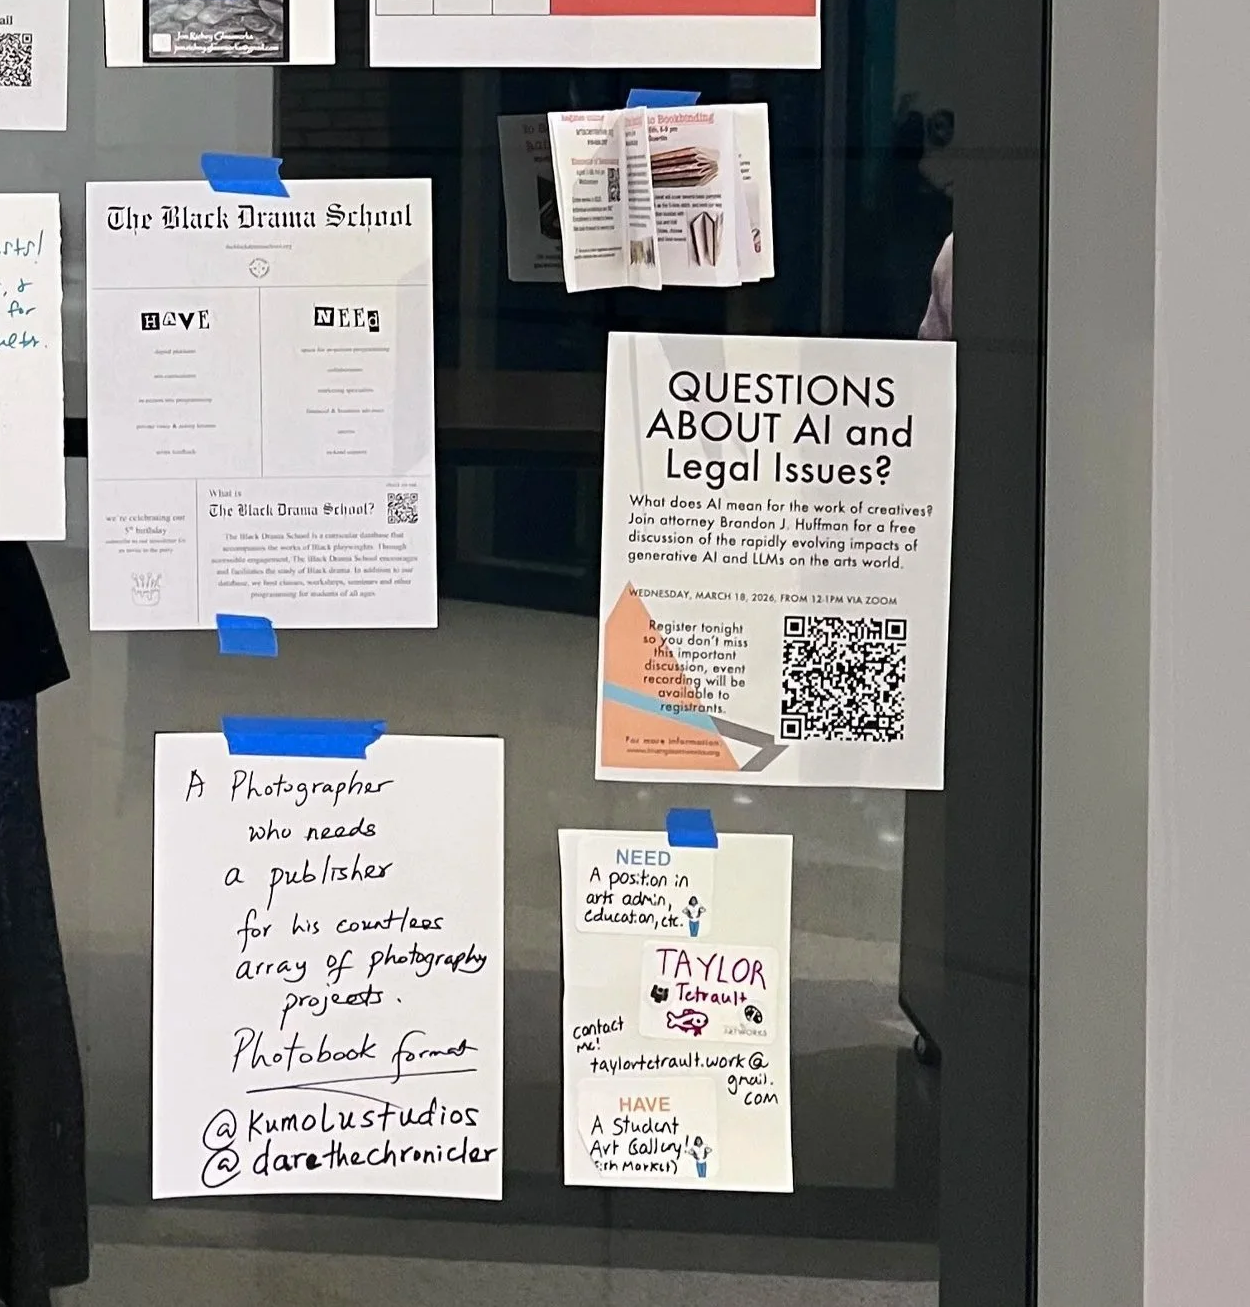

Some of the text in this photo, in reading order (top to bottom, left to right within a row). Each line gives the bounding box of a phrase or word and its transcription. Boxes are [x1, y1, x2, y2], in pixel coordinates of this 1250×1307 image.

[108, 204, 411, 235] The Black Drama School
[141, 310, 209, 330] HAVE
[669, 371, 894, 408] QUESTIONS
[646, 408, 912, 447] ABOUT AI and
[668, 448, 891, 490] Legal Issues?
[209, 489, 231, 497] What
[209, 503, 374, 517] The Black Drama School?
[629, 513, 654, 524] Join
[660, 516, 714, 530] attorney
[721, 516, 775, 529] Brandon
[780, 517, 790, 530] J.
[796, 518, 848, 531] Huffman
[854, 519, 871, 531] for
[890, 520, 915, 534] free
[186, 769, 394, 806] A Photographer
[249, 818, 375, 842] who needs
[617, 849, 670, 866] NEED
[225, 853, 393, 910] a publisher
[590, 867, 688, 890] A position in
[656, 949, 766, 990] TAYLOR
[676, 982, 747, 1006] Tetrault
[233, 1028, 376, 1072] Photobook
[620, 1097, 670, 1112] HAVE
